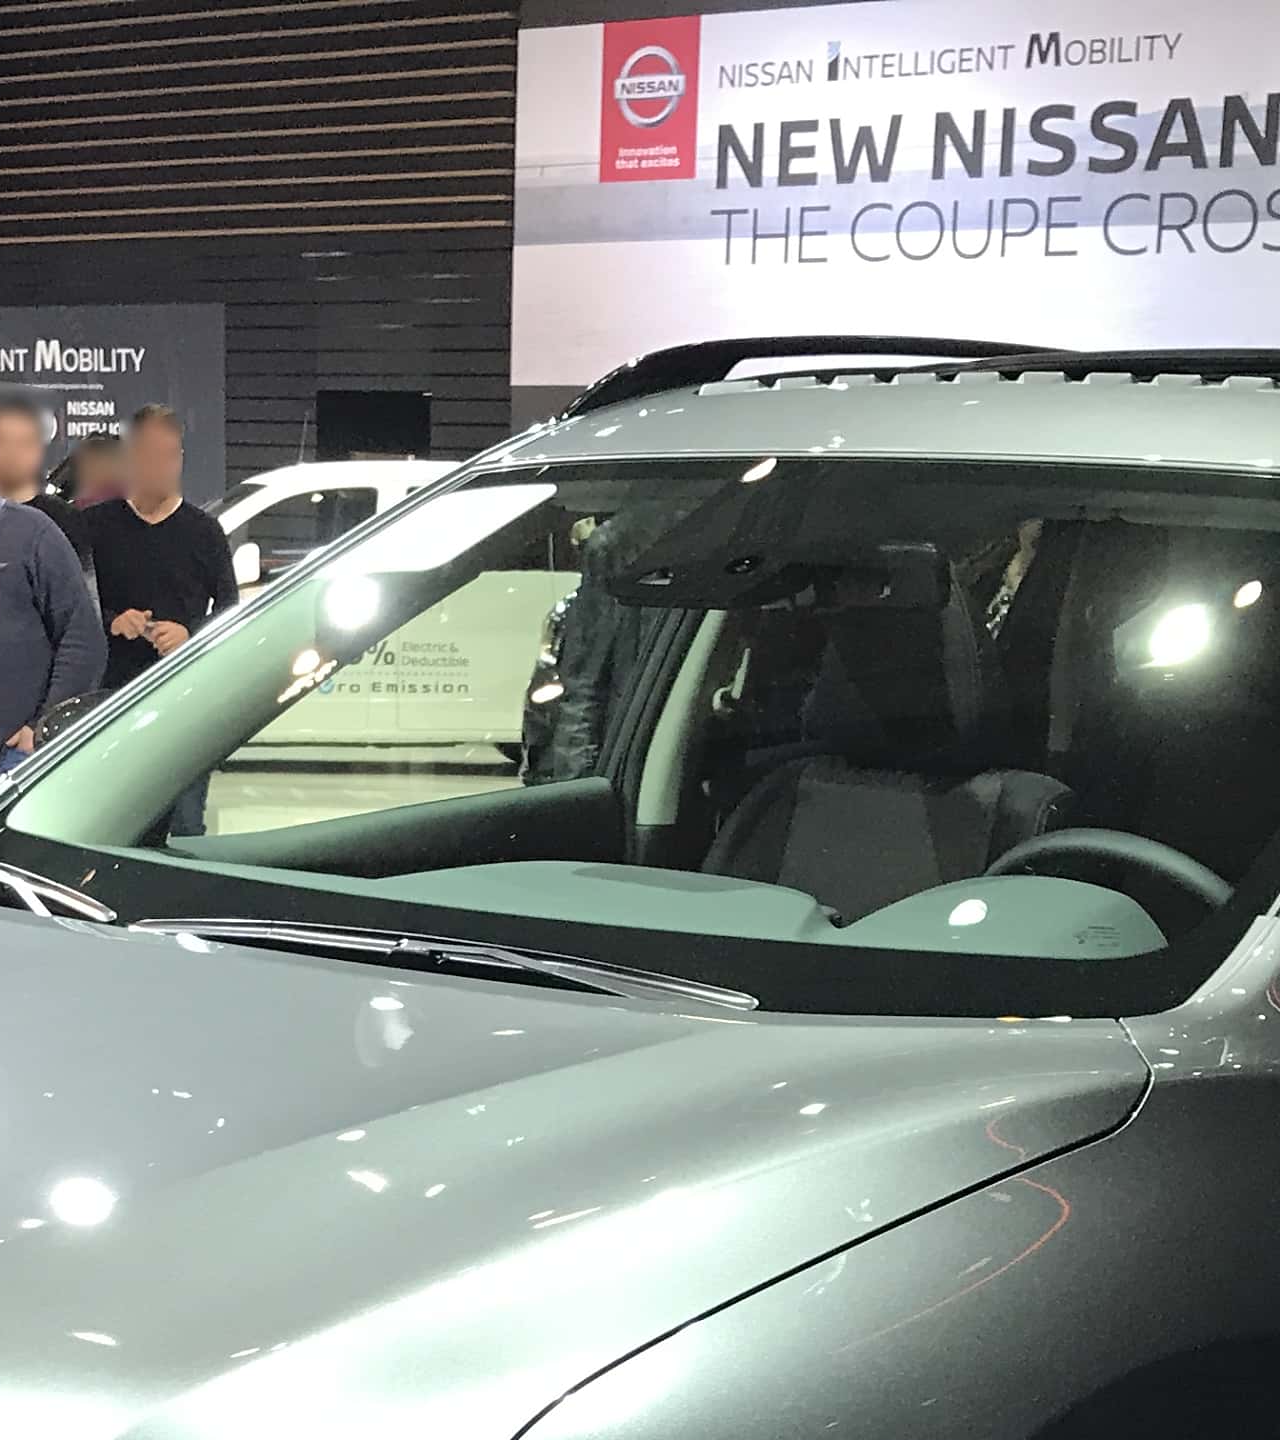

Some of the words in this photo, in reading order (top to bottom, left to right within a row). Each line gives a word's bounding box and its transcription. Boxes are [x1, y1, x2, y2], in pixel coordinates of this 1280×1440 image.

[718, 59, 814, 89] NISSAN
[1024, 31, 1184, 69] MOBILITY
[619, 79, 681, 95] NISSAN
[618, 144, 678, 157] Innovation
[715, 114, 903, 190] NEW
[615, 157, 638, 169] that
[639, 156, 680, 168] excites
[709, 204, 831, 265] THE
[850, 195, 1082, 262] COUPE
[34, 339, 145, 373] MOBILITY
[67, 401, 114, 416] NISSAN
[402, 642, 446, 653] Electric
[401, 656, 470, 667] Deductible
[372, 680, 469, 694] Emission
